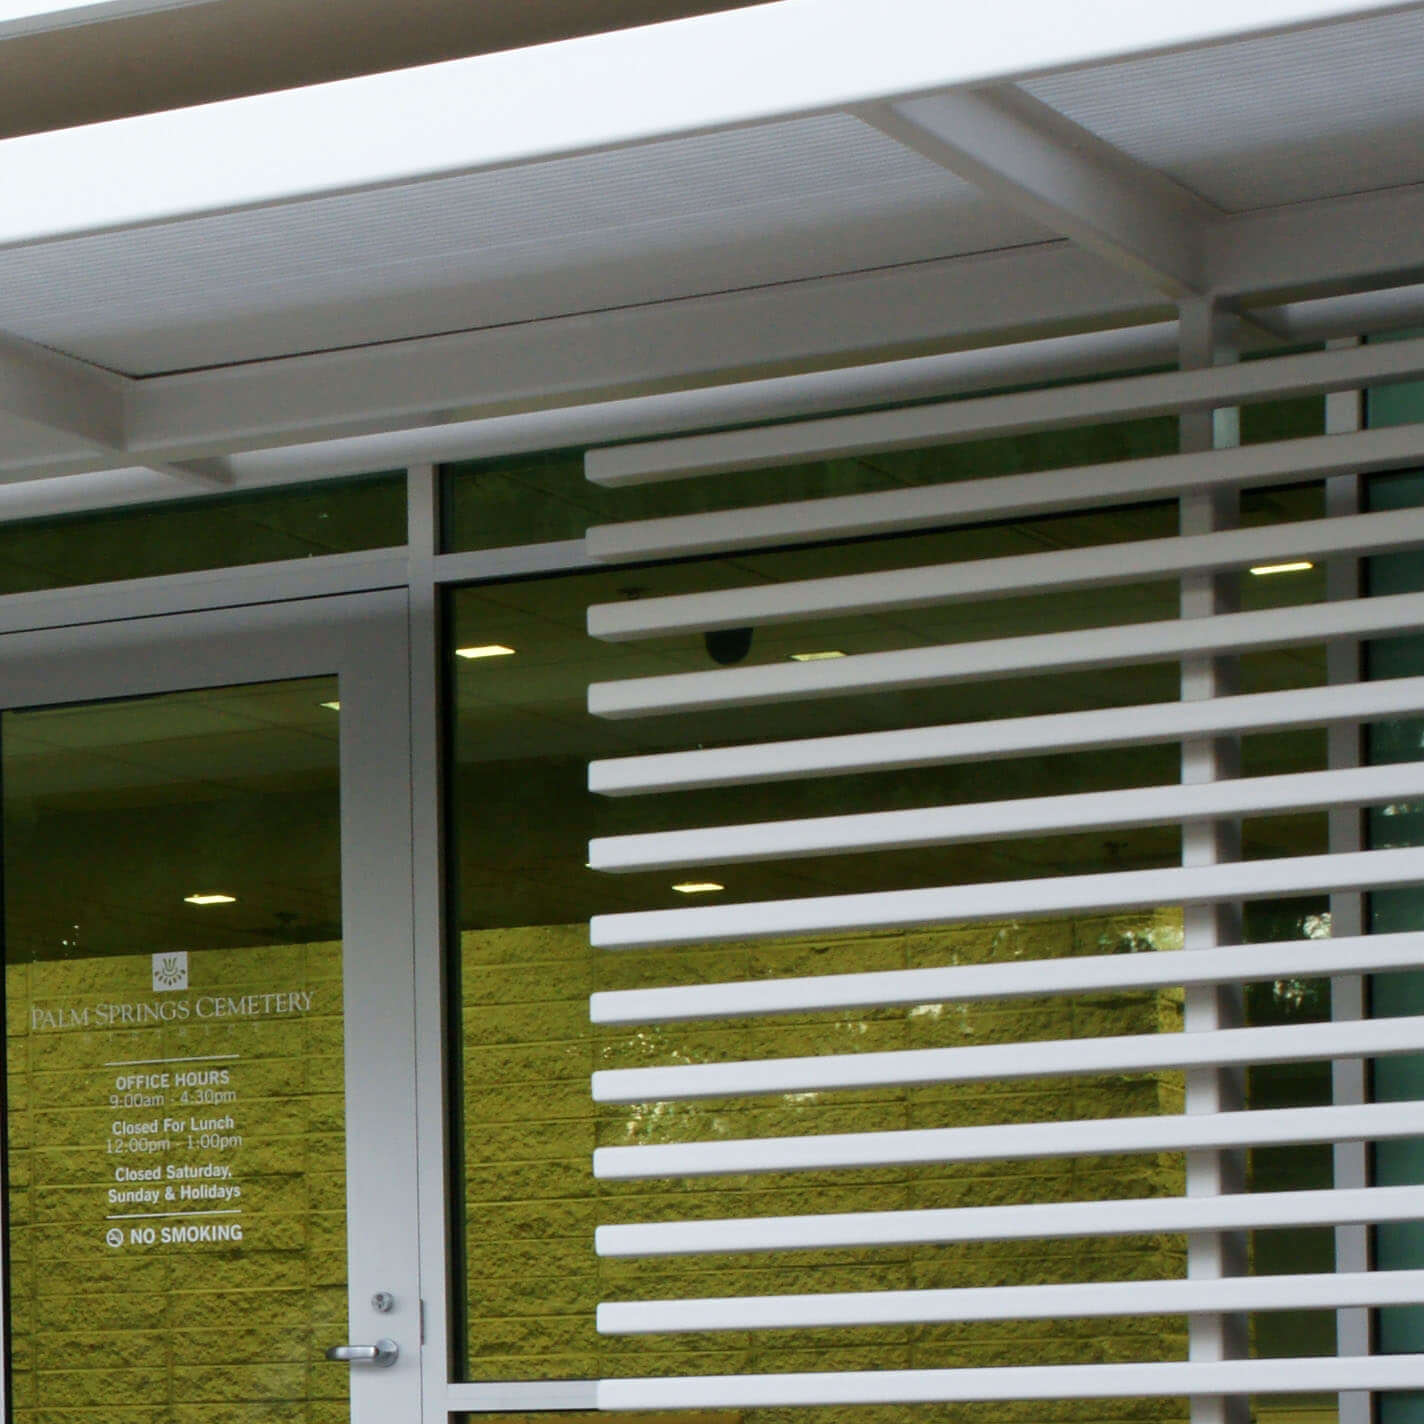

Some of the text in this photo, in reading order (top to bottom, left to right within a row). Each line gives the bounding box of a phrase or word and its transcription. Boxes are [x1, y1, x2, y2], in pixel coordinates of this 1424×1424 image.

[31, 991, 316, 1030] PALM SPRINGS CEMETERY
[116, 1070, 230, 1090] OFFICE HOURS
[109, 1093, 165, 1109] 9:00am
[112, 1114, 235, 1135] Closed For Lunch
[106, 1138, 170, 1153] 12:00pm
[187, 1134, 243, 1151] 1:00pm
[115, 1166, 162, 1182] Closed
[108, 1184, 241, 1204] Sunday & Holidays
[130, 1224, 243, 1244] NO SMOKING
